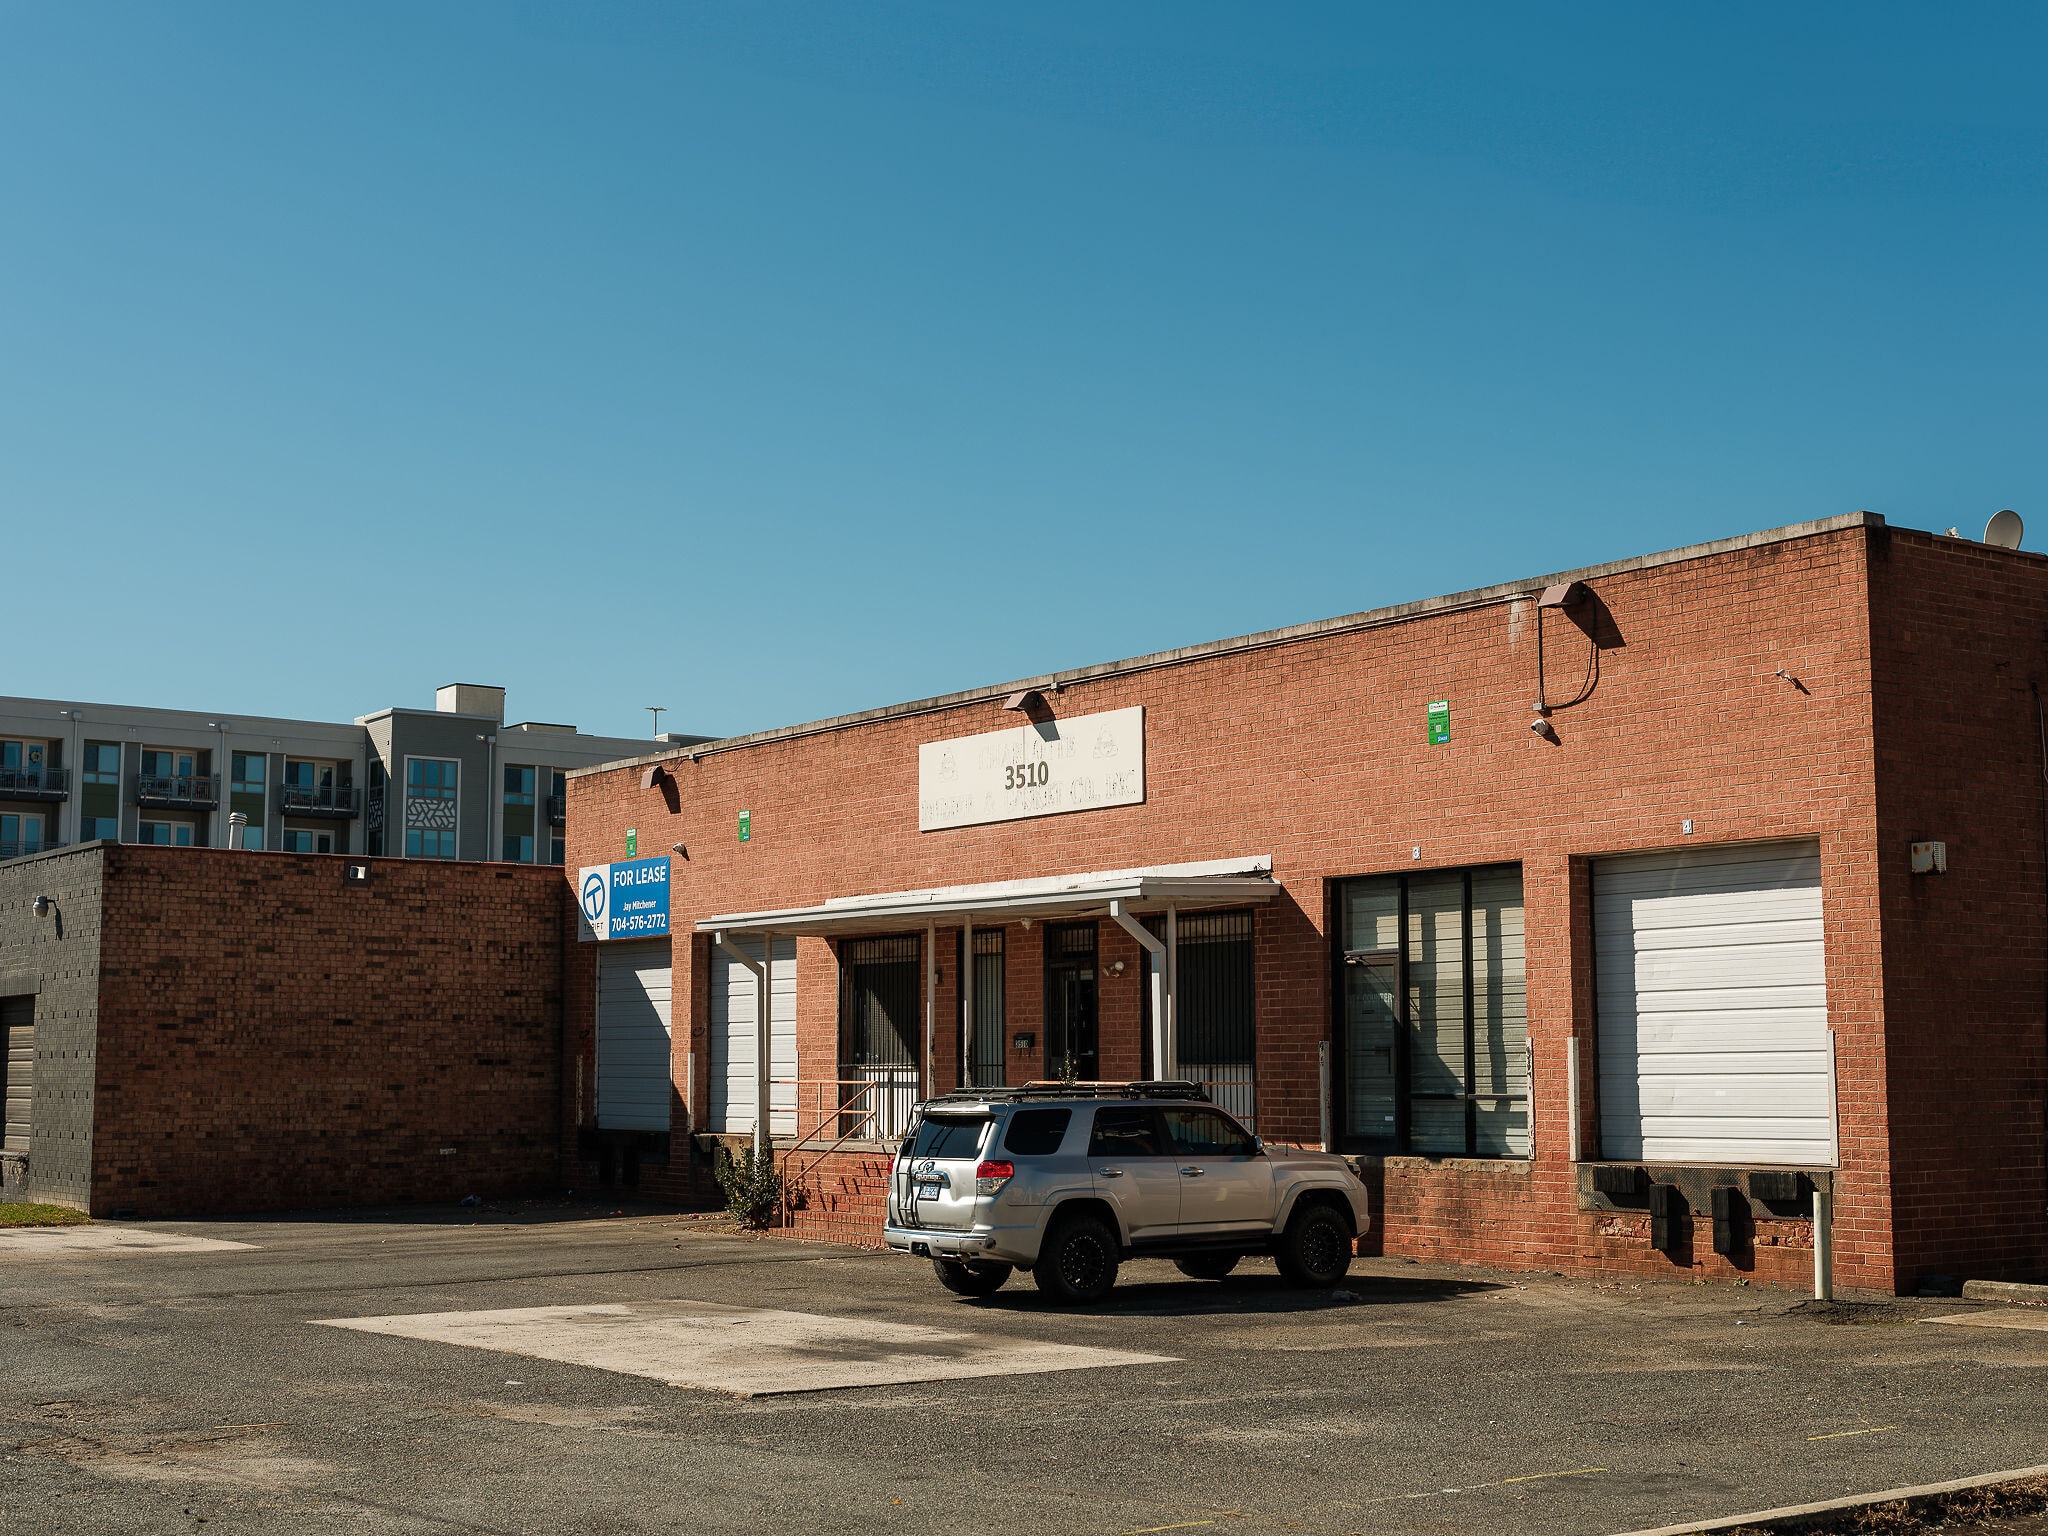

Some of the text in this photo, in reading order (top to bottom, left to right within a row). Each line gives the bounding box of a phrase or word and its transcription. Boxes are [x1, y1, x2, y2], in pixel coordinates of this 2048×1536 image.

[1005, 761, 1049, 790] 3510
[613, 866, 666, 888] FOR LEASE
[623, 900, 657, 912] Jay Mitchener
[611, 913, 666, 931] 704-576-2772
